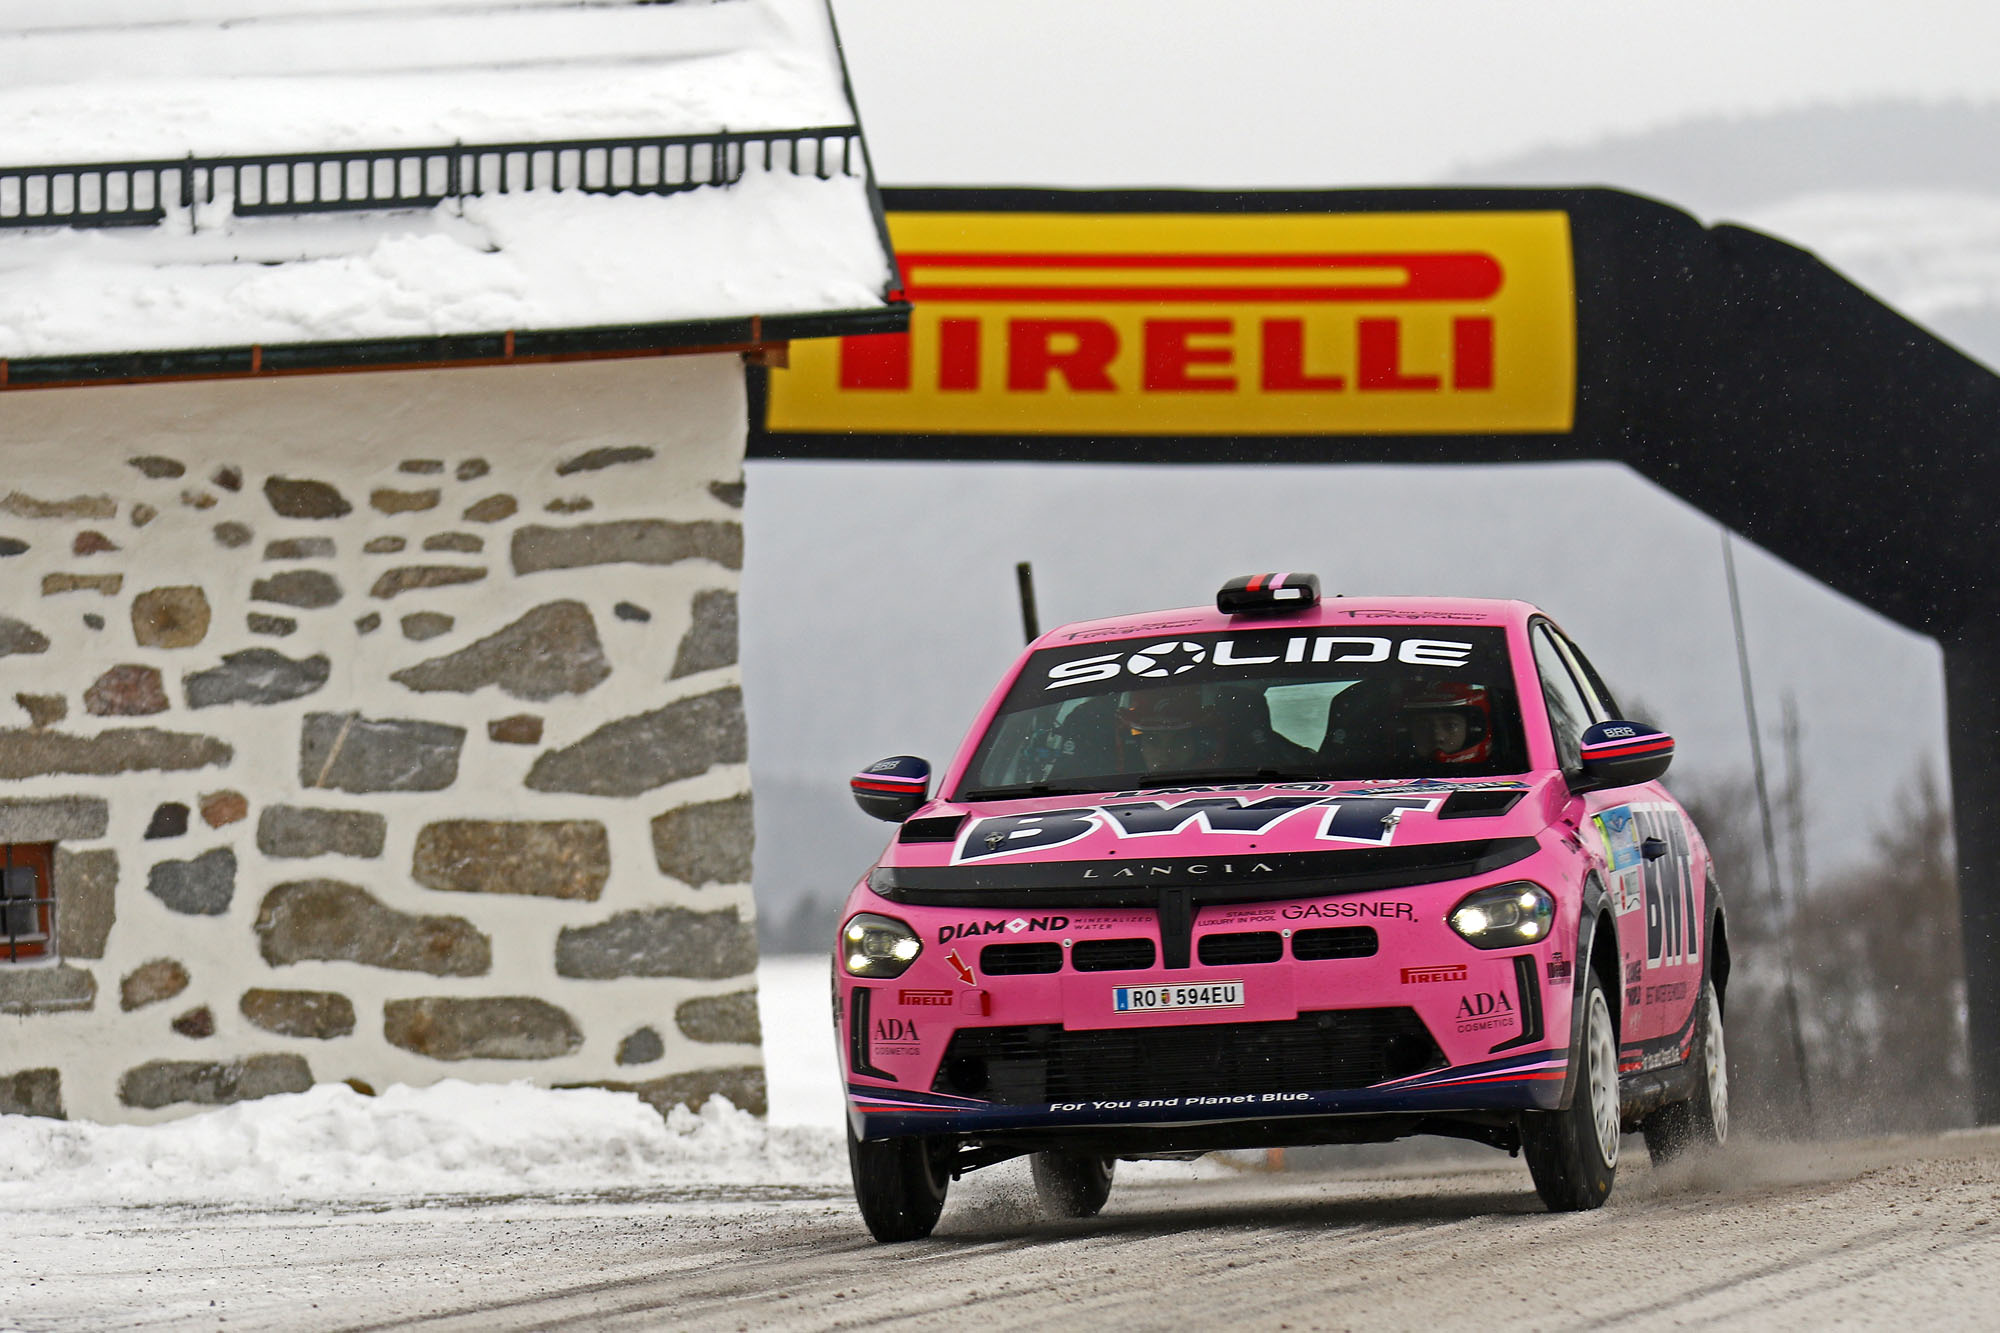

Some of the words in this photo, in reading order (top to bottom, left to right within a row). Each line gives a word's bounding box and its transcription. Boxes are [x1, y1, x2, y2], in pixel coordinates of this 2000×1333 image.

[1044, 636, 1473, 691] SOLIDE
[1602, 727, 1635, 738] BRR
[949, 795, 1444, 867] BWT
[1083, 863, 1273, 878] LANCIA
[1630, 802, 1700, 970] BWT
[1198, 918, 1234, 927] LUXURY
[1226, 909, 1276, 917] STAINLESS
[938, 916, 1069, 945] DIAMOND
[1400, 964, 1468, 984] PIRELLI
[898, 989, 953, 1006] PIRELLI
[1133, 989, 1157, 1007] RO
[1176, 985, 1236, 1005] 594EU
[1455, 989, 1514, 1019] ADA
[874, 1018, 921, 1041] ADA
[1457, 1017, 1514, 1033] COSMETICS
[1050, 1103, 1085, 1112] For
[1092, 1100, 1131, 1110] You
[1138, 1098, 1178, 1108] and
[1185, 1094, 1255, 1106] Planet
[1262, 1092, 1315, 1102] Blue.
